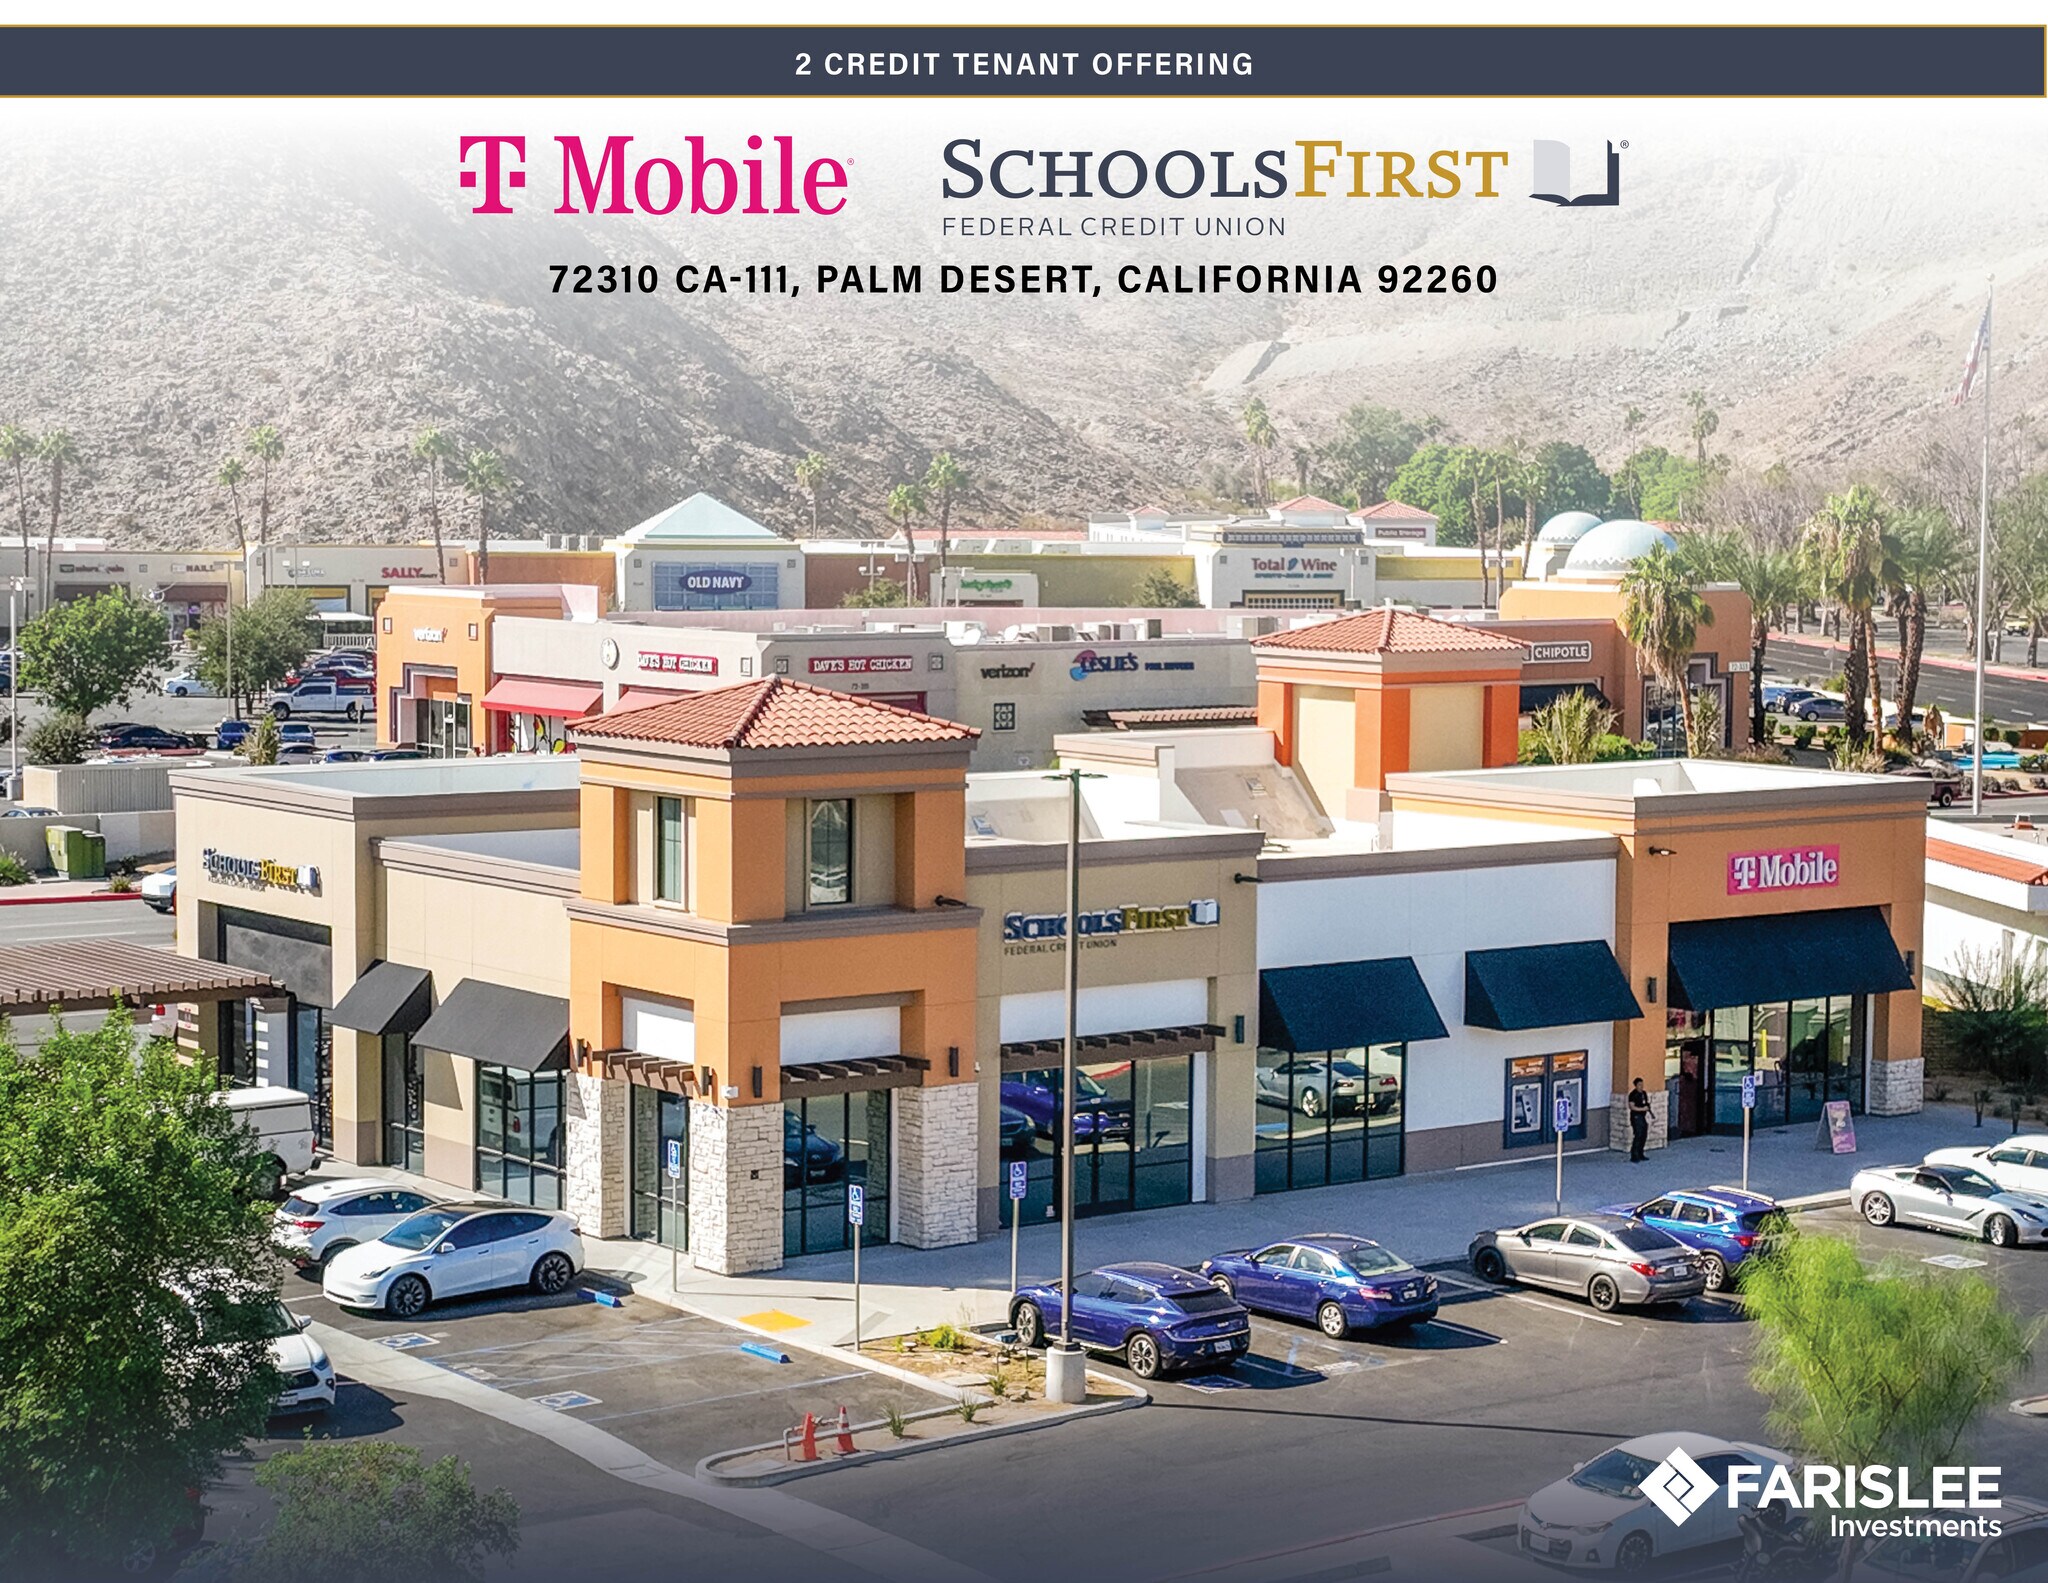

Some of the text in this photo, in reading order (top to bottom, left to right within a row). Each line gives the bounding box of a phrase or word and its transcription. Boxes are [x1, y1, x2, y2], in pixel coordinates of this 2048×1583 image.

[1251, 557, 1338, 571] Total Wine
[382, 567, 423, 578] SALLY
[687, 576, 744, 588] OLD NAVY
[1534, 646, 1588, 658] CHIPOTLE
[847, 659, 867, 671] HOT
[1080, 652, 1139, 673] LESLIE'S
[981, 664, 1030, 679] verizon
[1757, 851, 1838, 888] Mobile
[1004, 939, 1117, 956] FEDERAL CRT UNION
